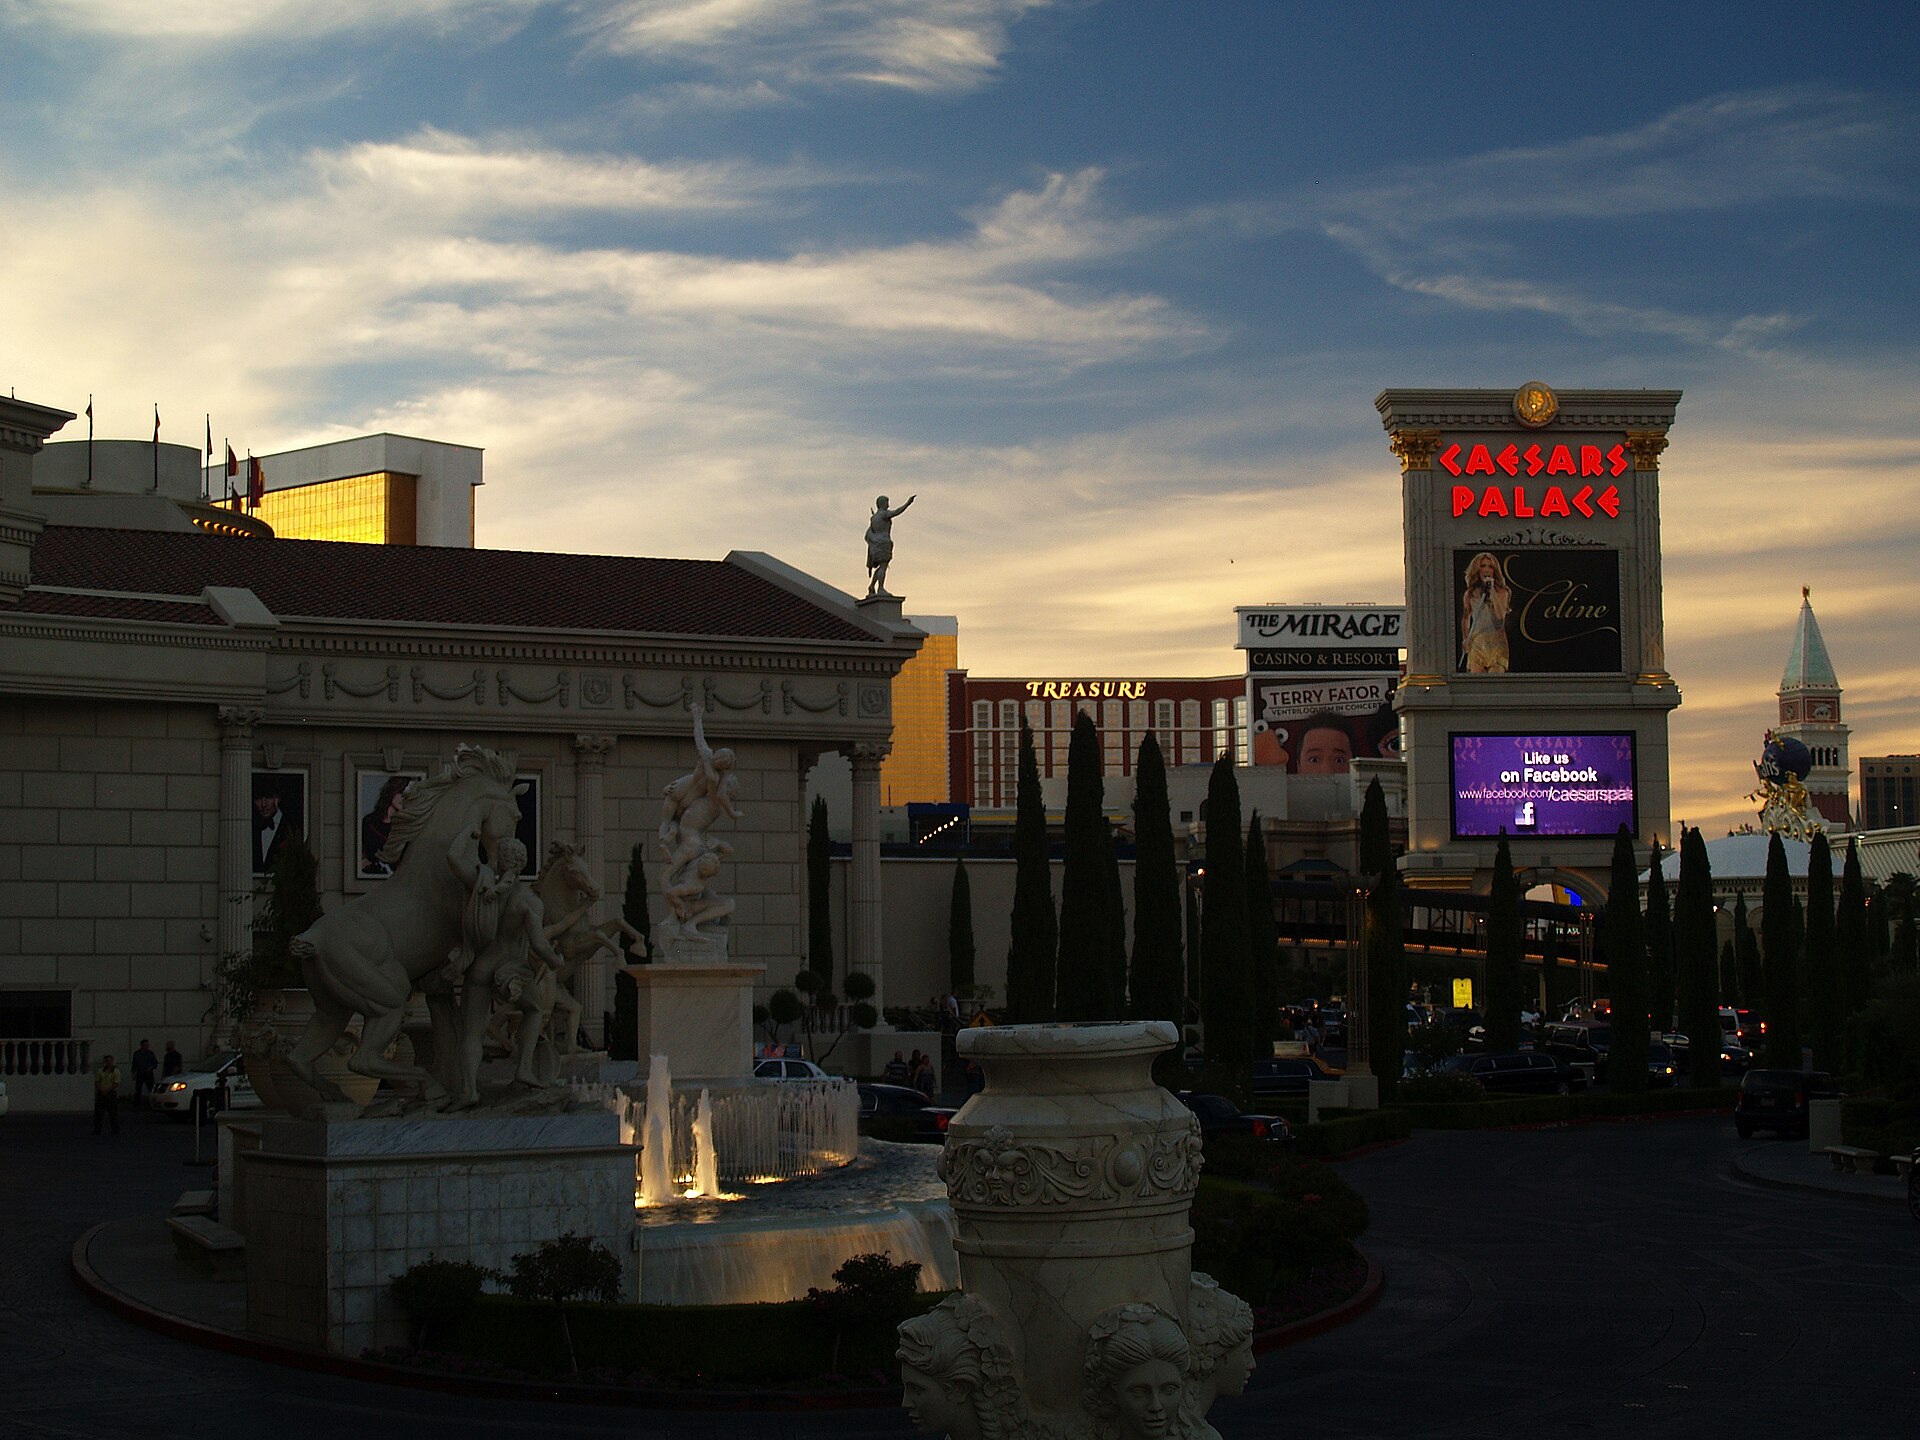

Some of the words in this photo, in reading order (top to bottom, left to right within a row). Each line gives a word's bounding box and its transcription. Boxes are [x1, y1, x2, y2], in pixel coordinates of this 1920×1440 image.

[1438, 442, 1629, 478] CAESARS
[1452, 484, 1620, 519] PALACE
[1246, 614, 1279, 627] THE
[1258, 613, 1400, 639] MIRAGE
[1253, 652, 1312, 665] CASINO
[1317, 653, 1328, 665] &
[1332, 652, 1396, 665] RESORT
[1025, 681, 1147, 699] TREASURE
[1270, 689, 1323, 705] TERRY
[1328, 685, 1380, 702] FATOR
[1344, 702, 1382, 711] CONCERT
[1524, 752, 1551, 765] Like
[1553, 755, 1570, 765] us
[1500, 770, 1520, 783] on
[1523, 766, 1598, 783] Facebook
